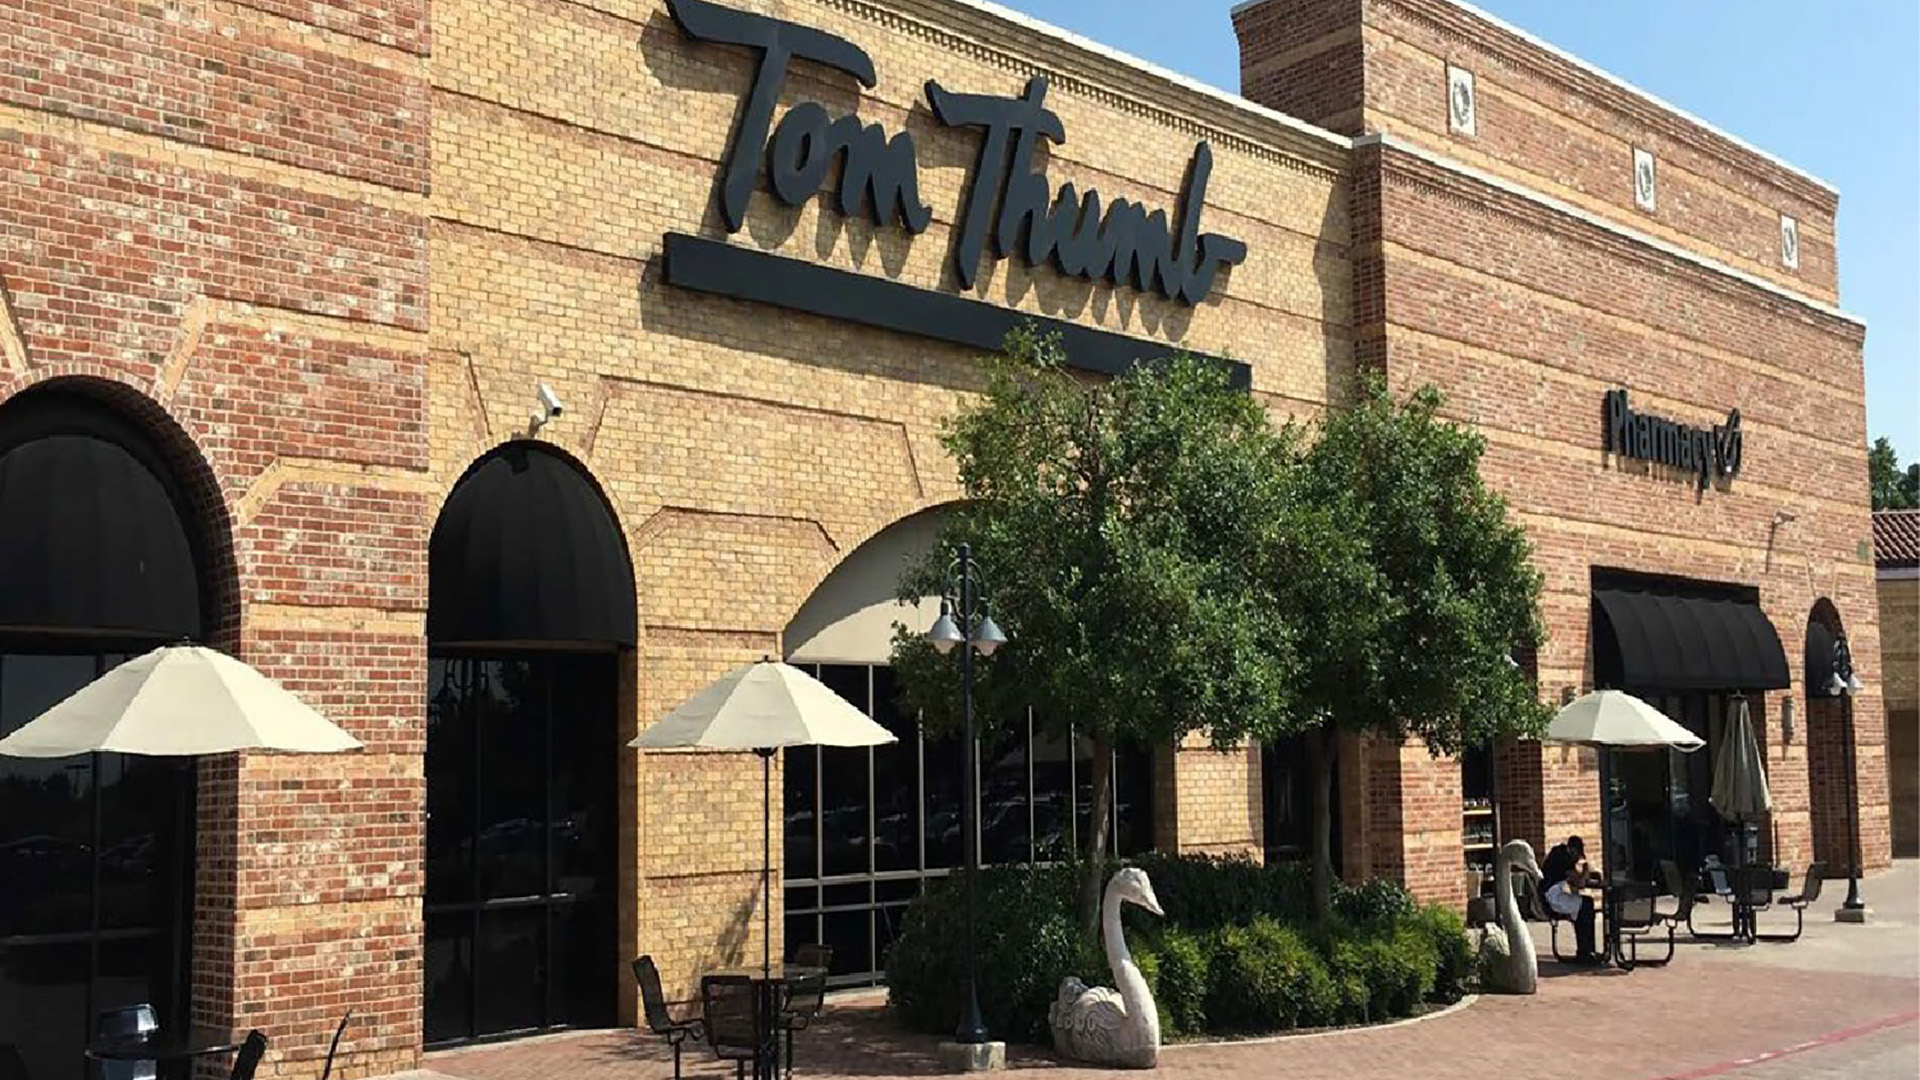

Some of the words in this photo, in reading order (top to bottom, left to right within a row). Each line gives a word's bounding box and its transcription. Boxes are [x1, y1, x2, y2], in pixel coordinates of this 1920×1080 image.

[665, 0, 932, 234] Tom
[925, 76, 1247, 306] Thumb
[1606, 389, 1714, 489] Pharmacy
